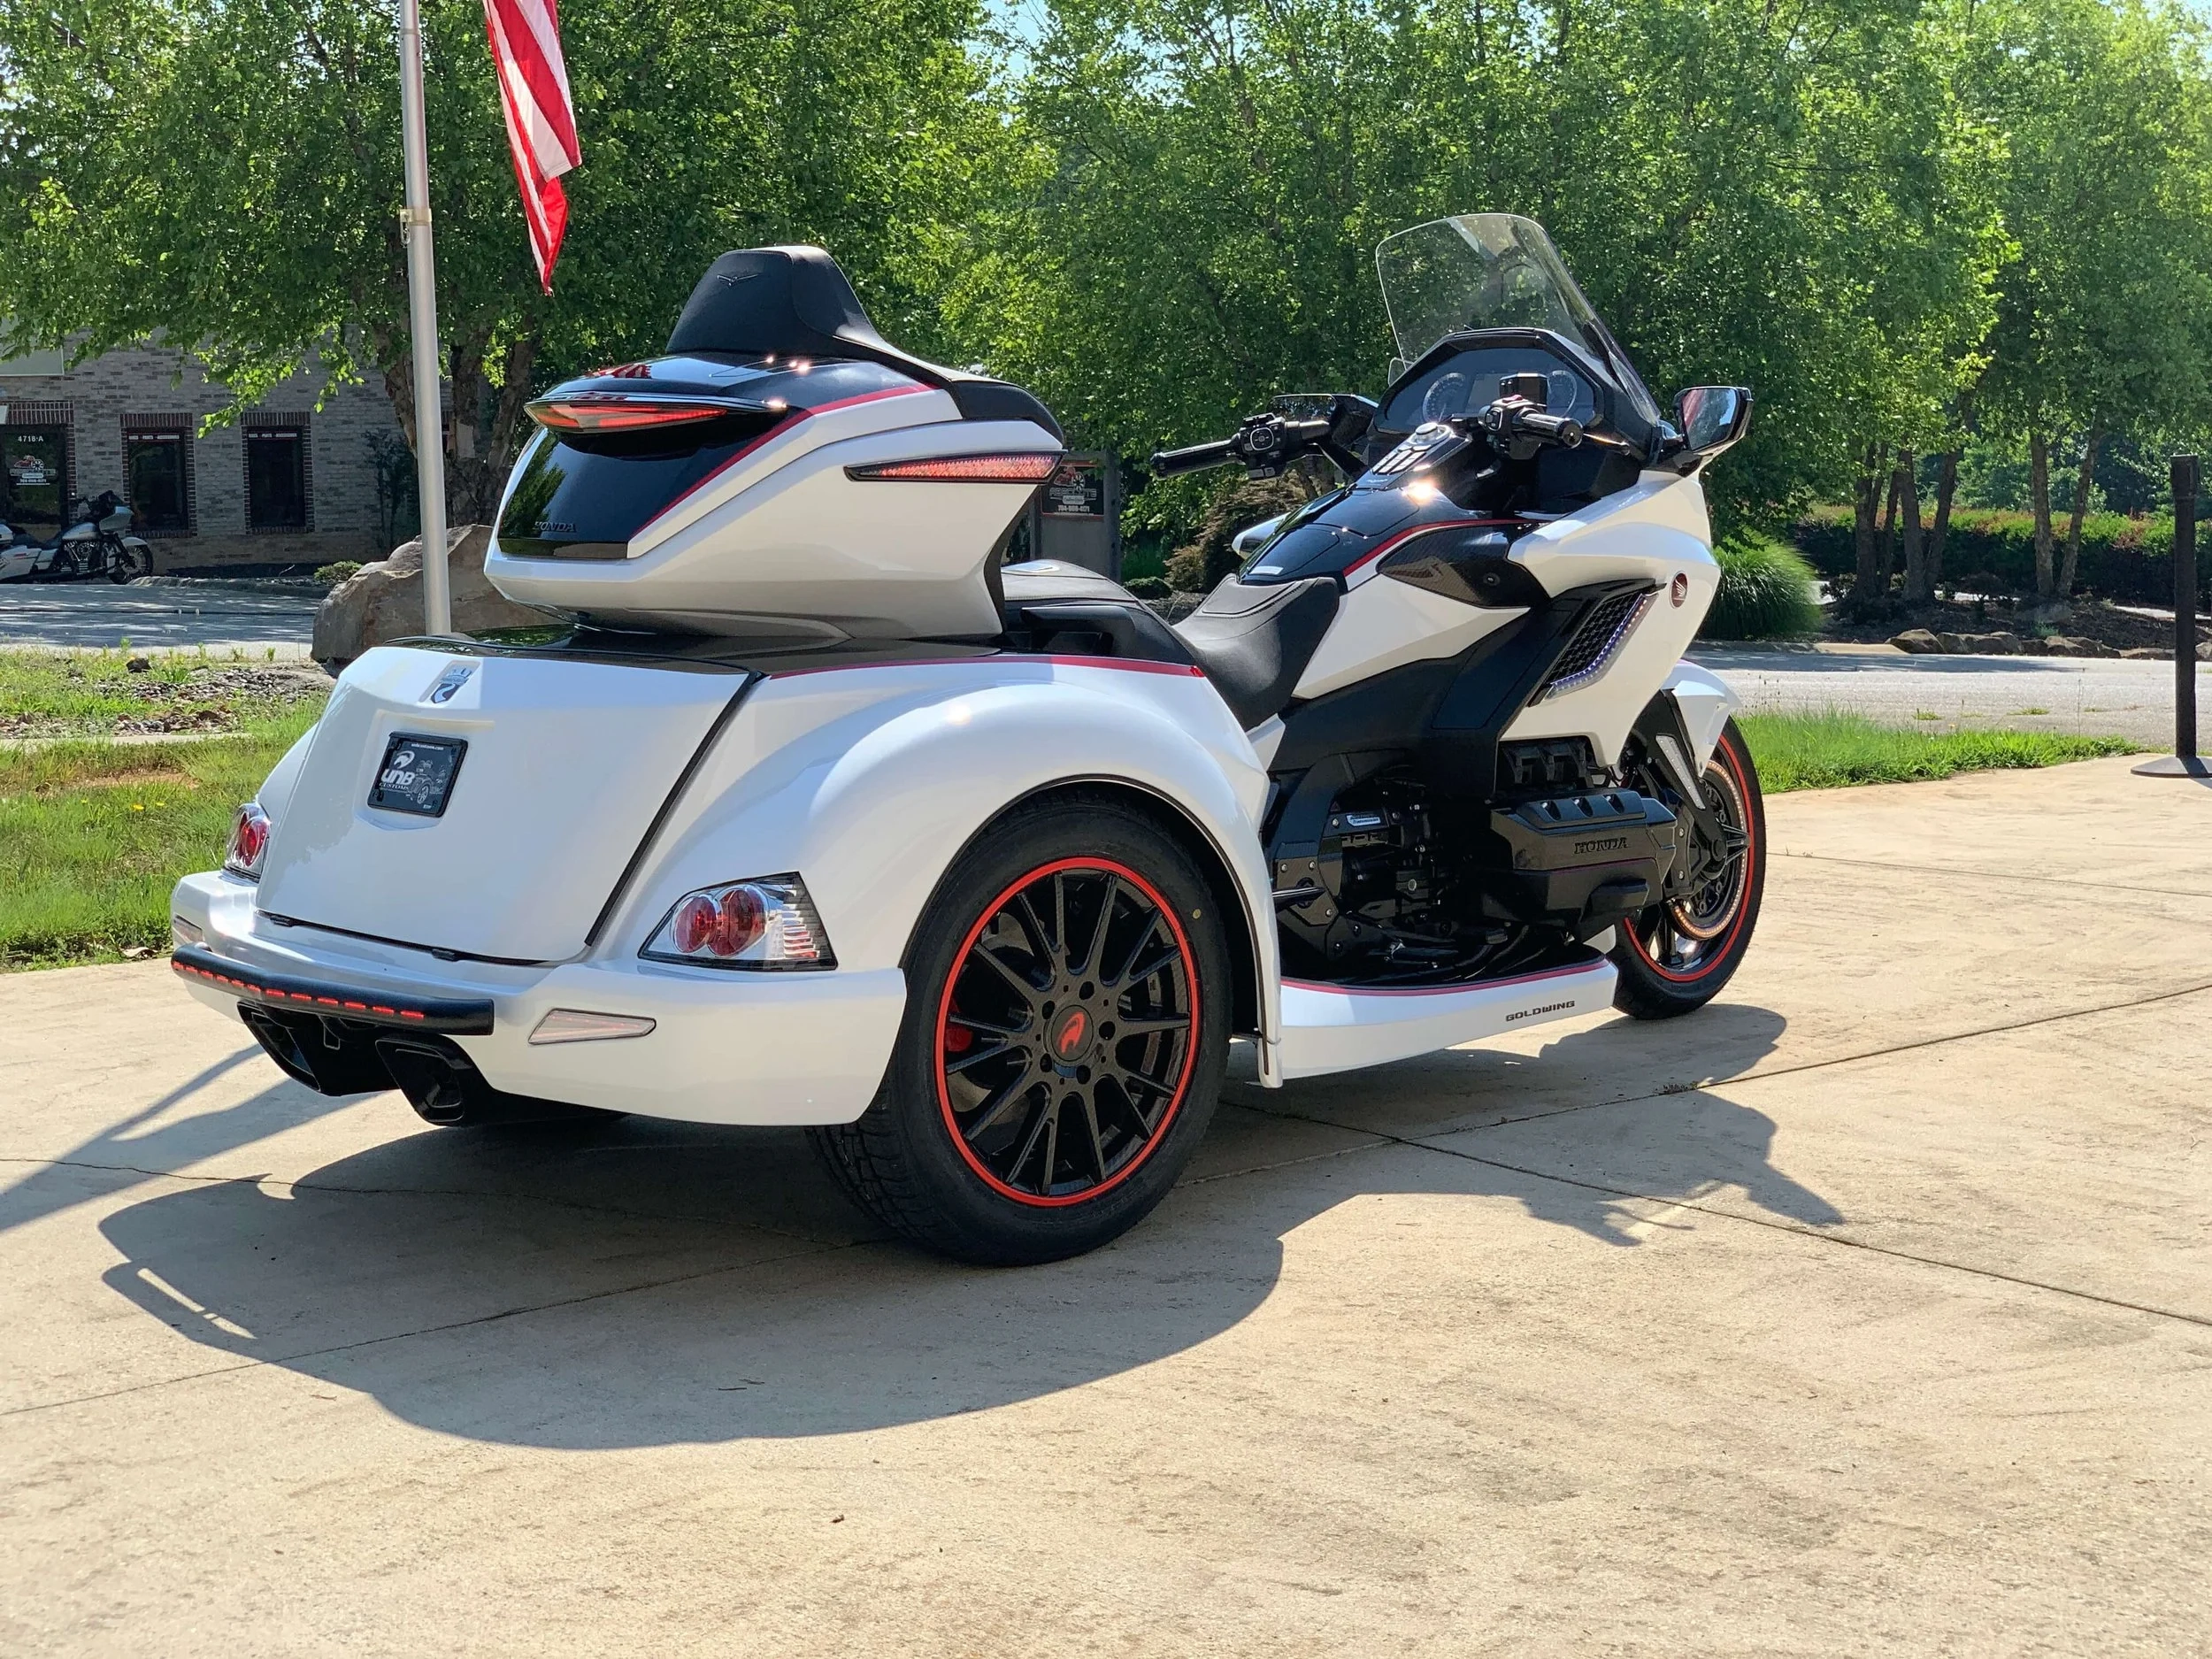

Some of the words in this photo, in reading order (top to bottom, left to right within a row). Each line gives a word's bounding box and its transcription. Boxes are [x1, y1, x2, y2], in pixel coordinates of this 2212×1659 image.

[533, 521, 575, 532] HONDA
[1574, 837, 1629, 854] HONDA
[1505, 1000, 1575, 1021] GOLDWING
